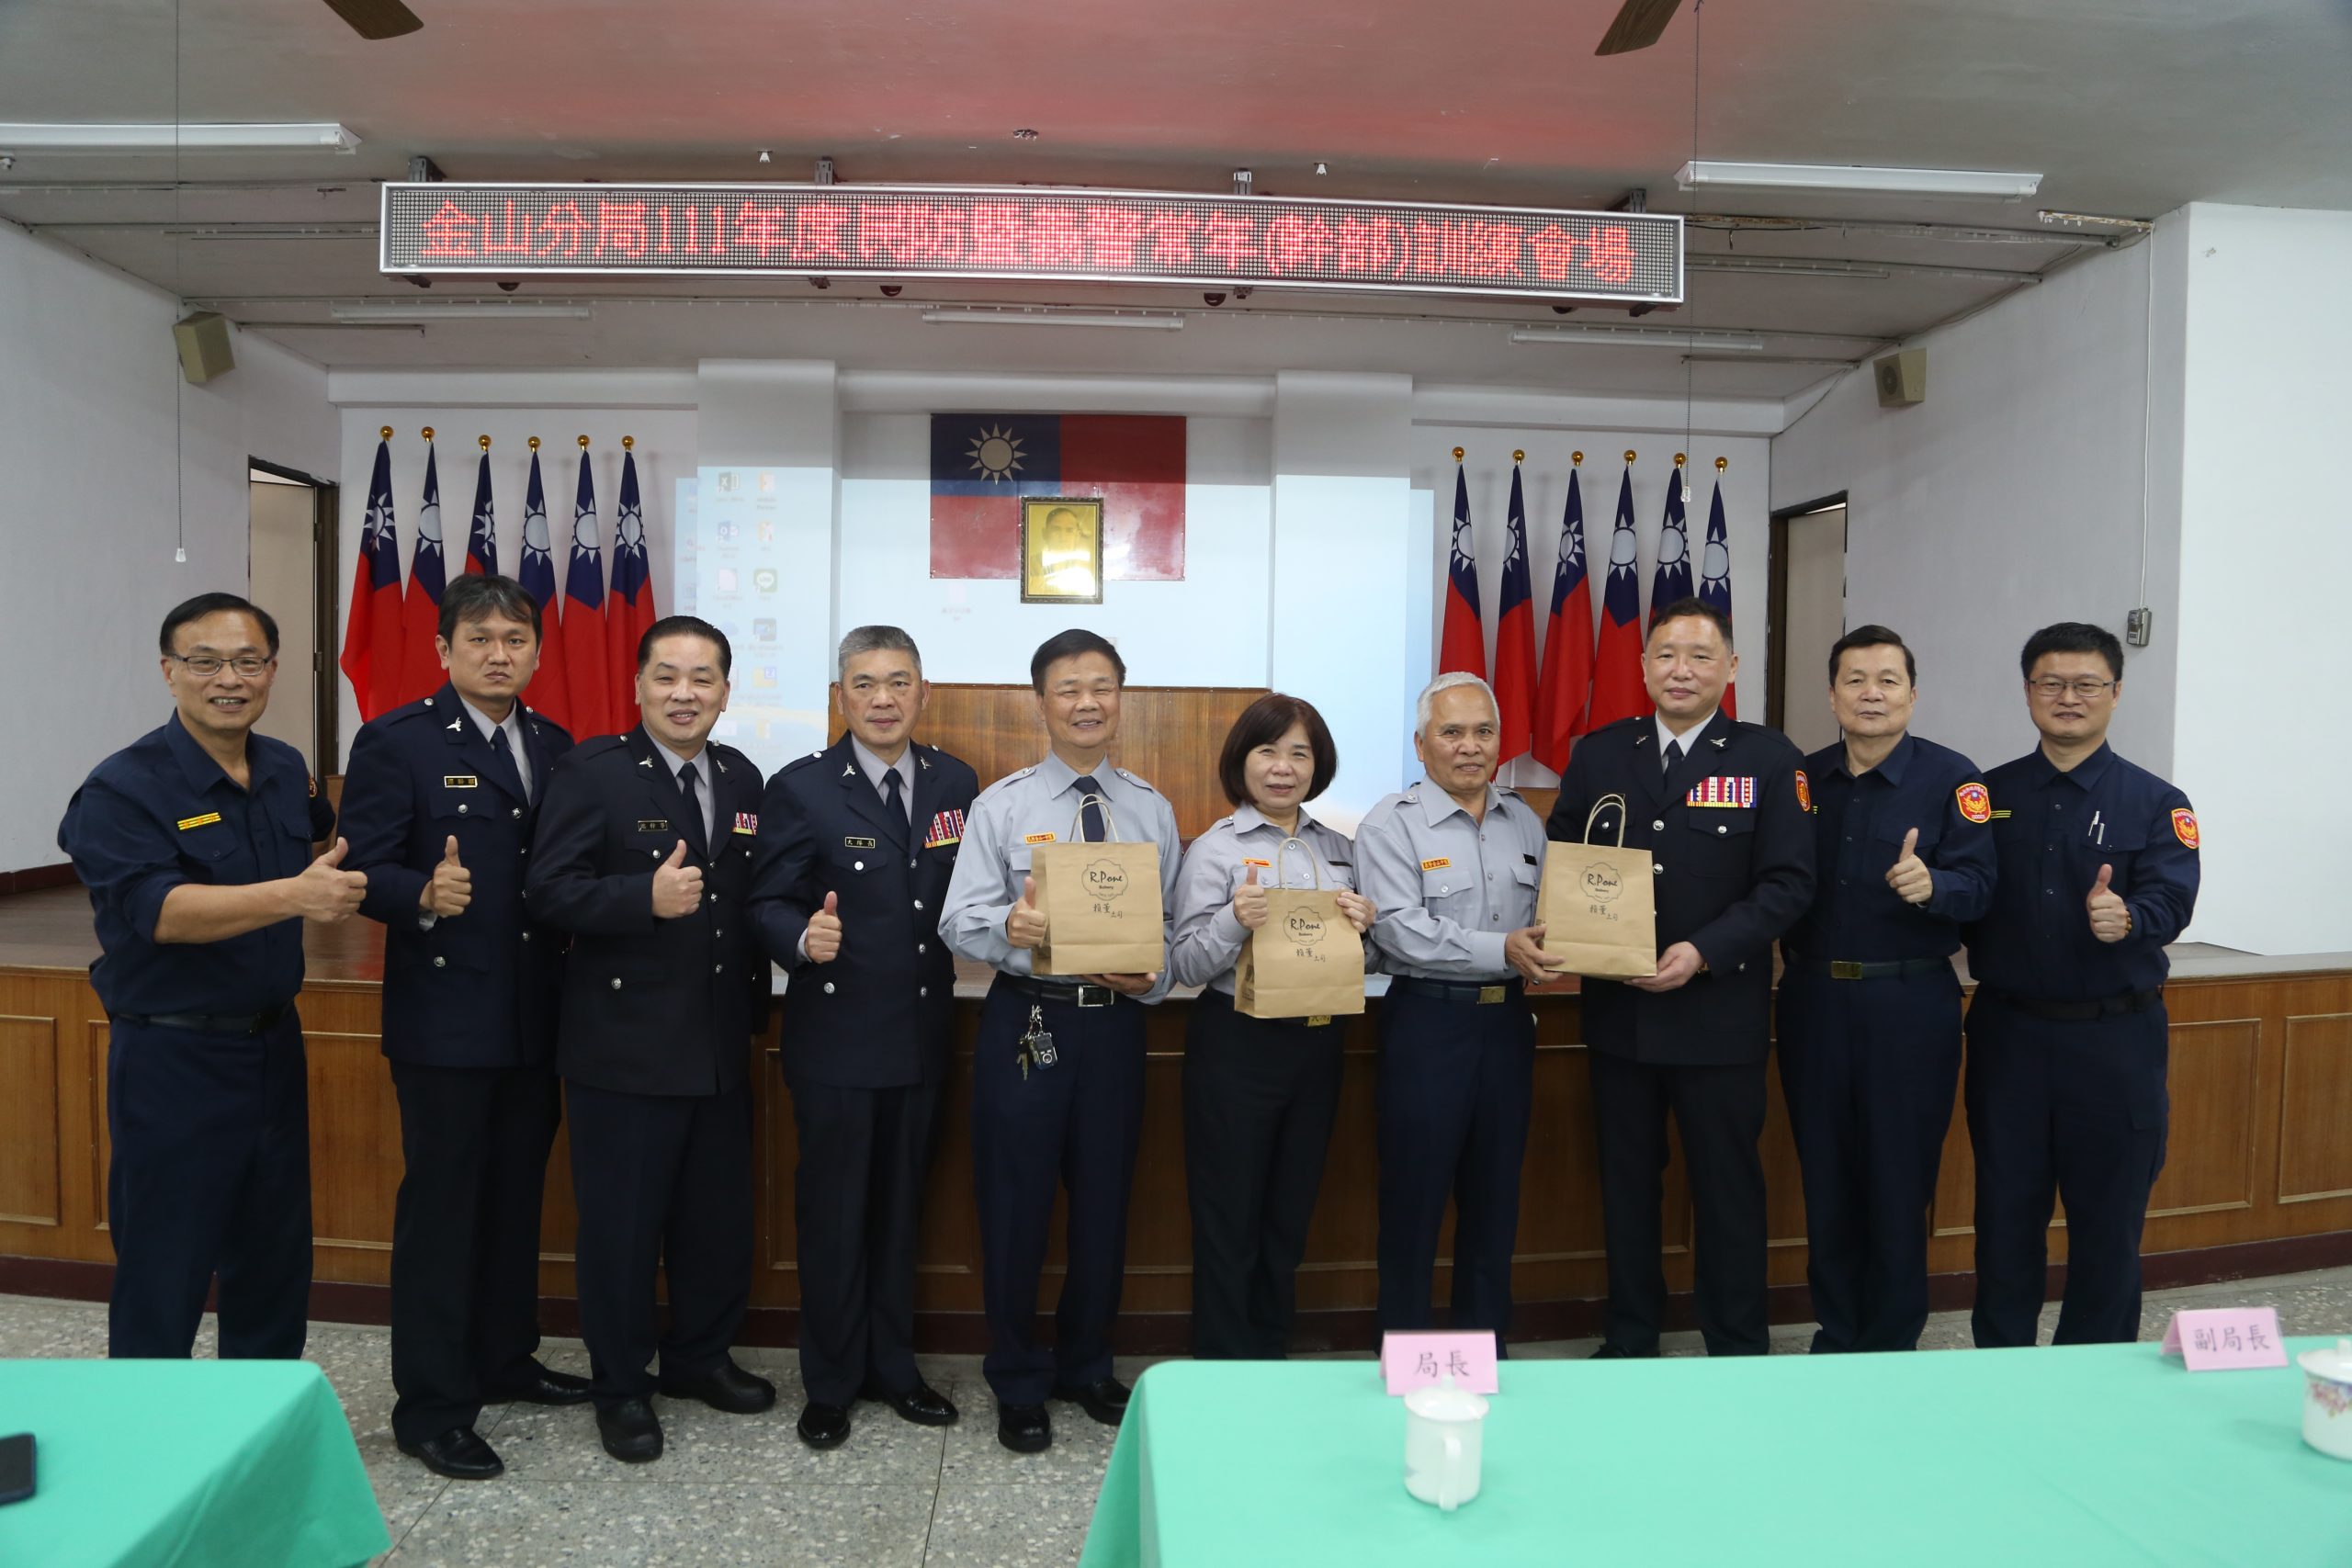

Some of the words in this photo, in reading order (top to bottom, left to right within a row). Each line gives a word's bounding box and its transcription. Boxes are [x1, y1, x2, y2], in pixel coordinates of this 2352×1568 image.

[2194, 1325, 2270, 1352] 副局長
[1414, 1350, 1470, 1378] 局長
